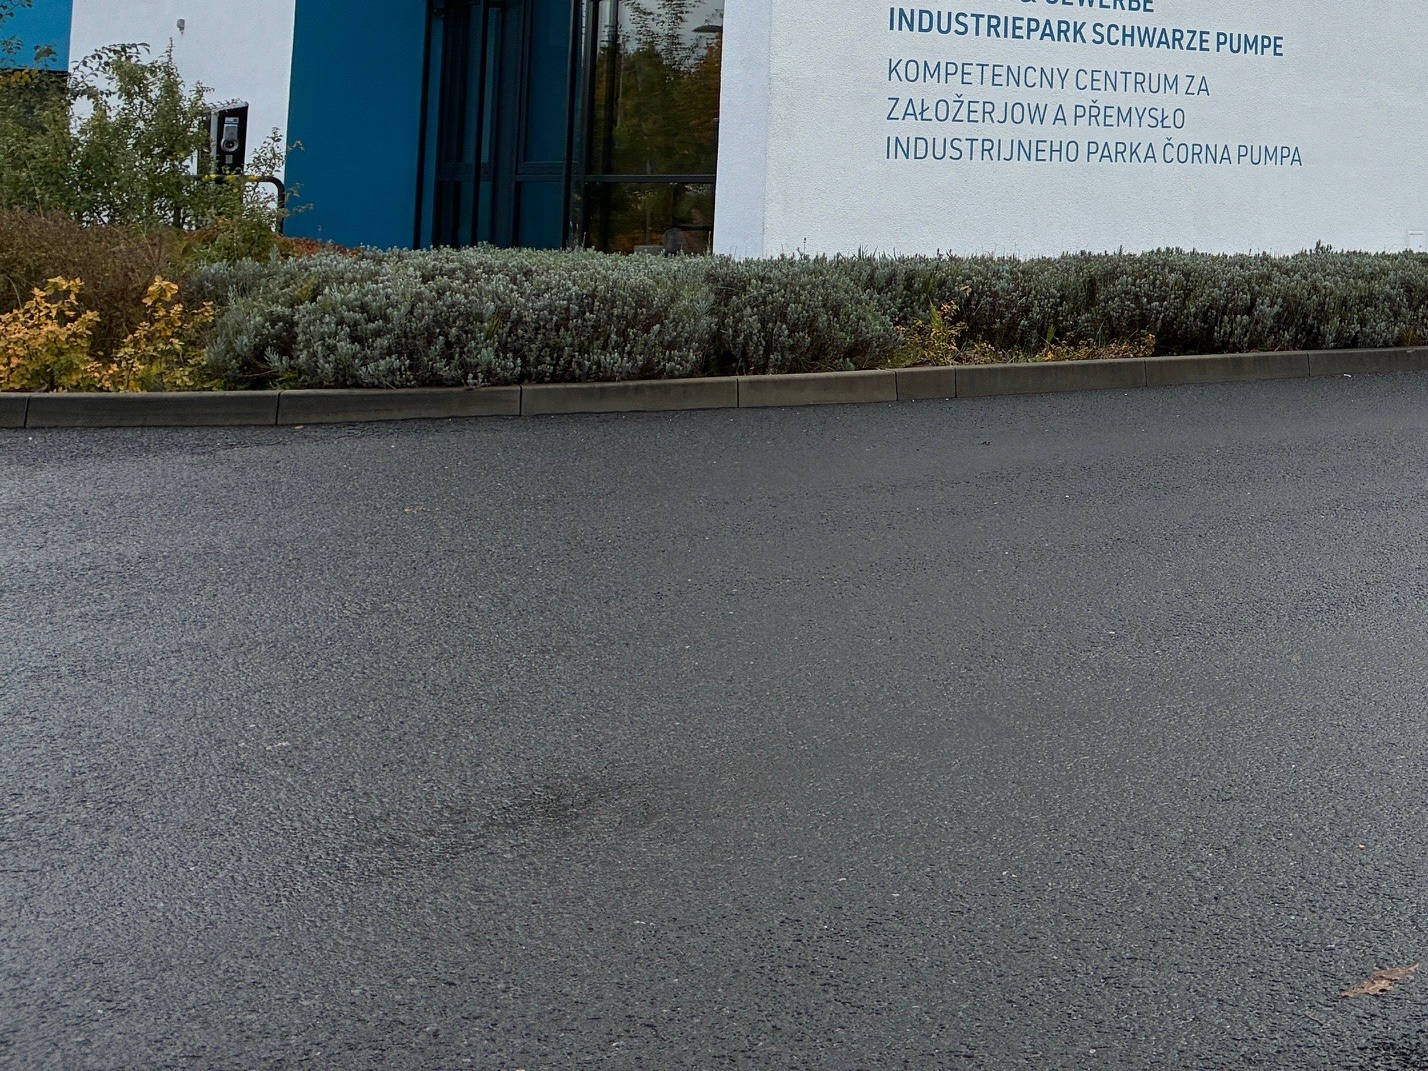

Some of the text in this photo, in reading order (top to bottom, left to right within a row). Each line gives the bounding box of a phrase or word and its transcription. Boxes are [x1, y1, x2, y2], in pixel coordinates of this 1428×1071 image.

[889, 7, 1284, 57] INDUSTRIEPARK SCHWARZE PUMPE
[888, 58, 1210, 97] KOMPETENCNY CENTRUM ZA
[886, 93, 1185, 129] ZAŁOŽERJOW A PŘEMYSŁO
[886, 136, 1303, 167] INDUSTRIJNEHO PARKA ČORNA PUMPA
